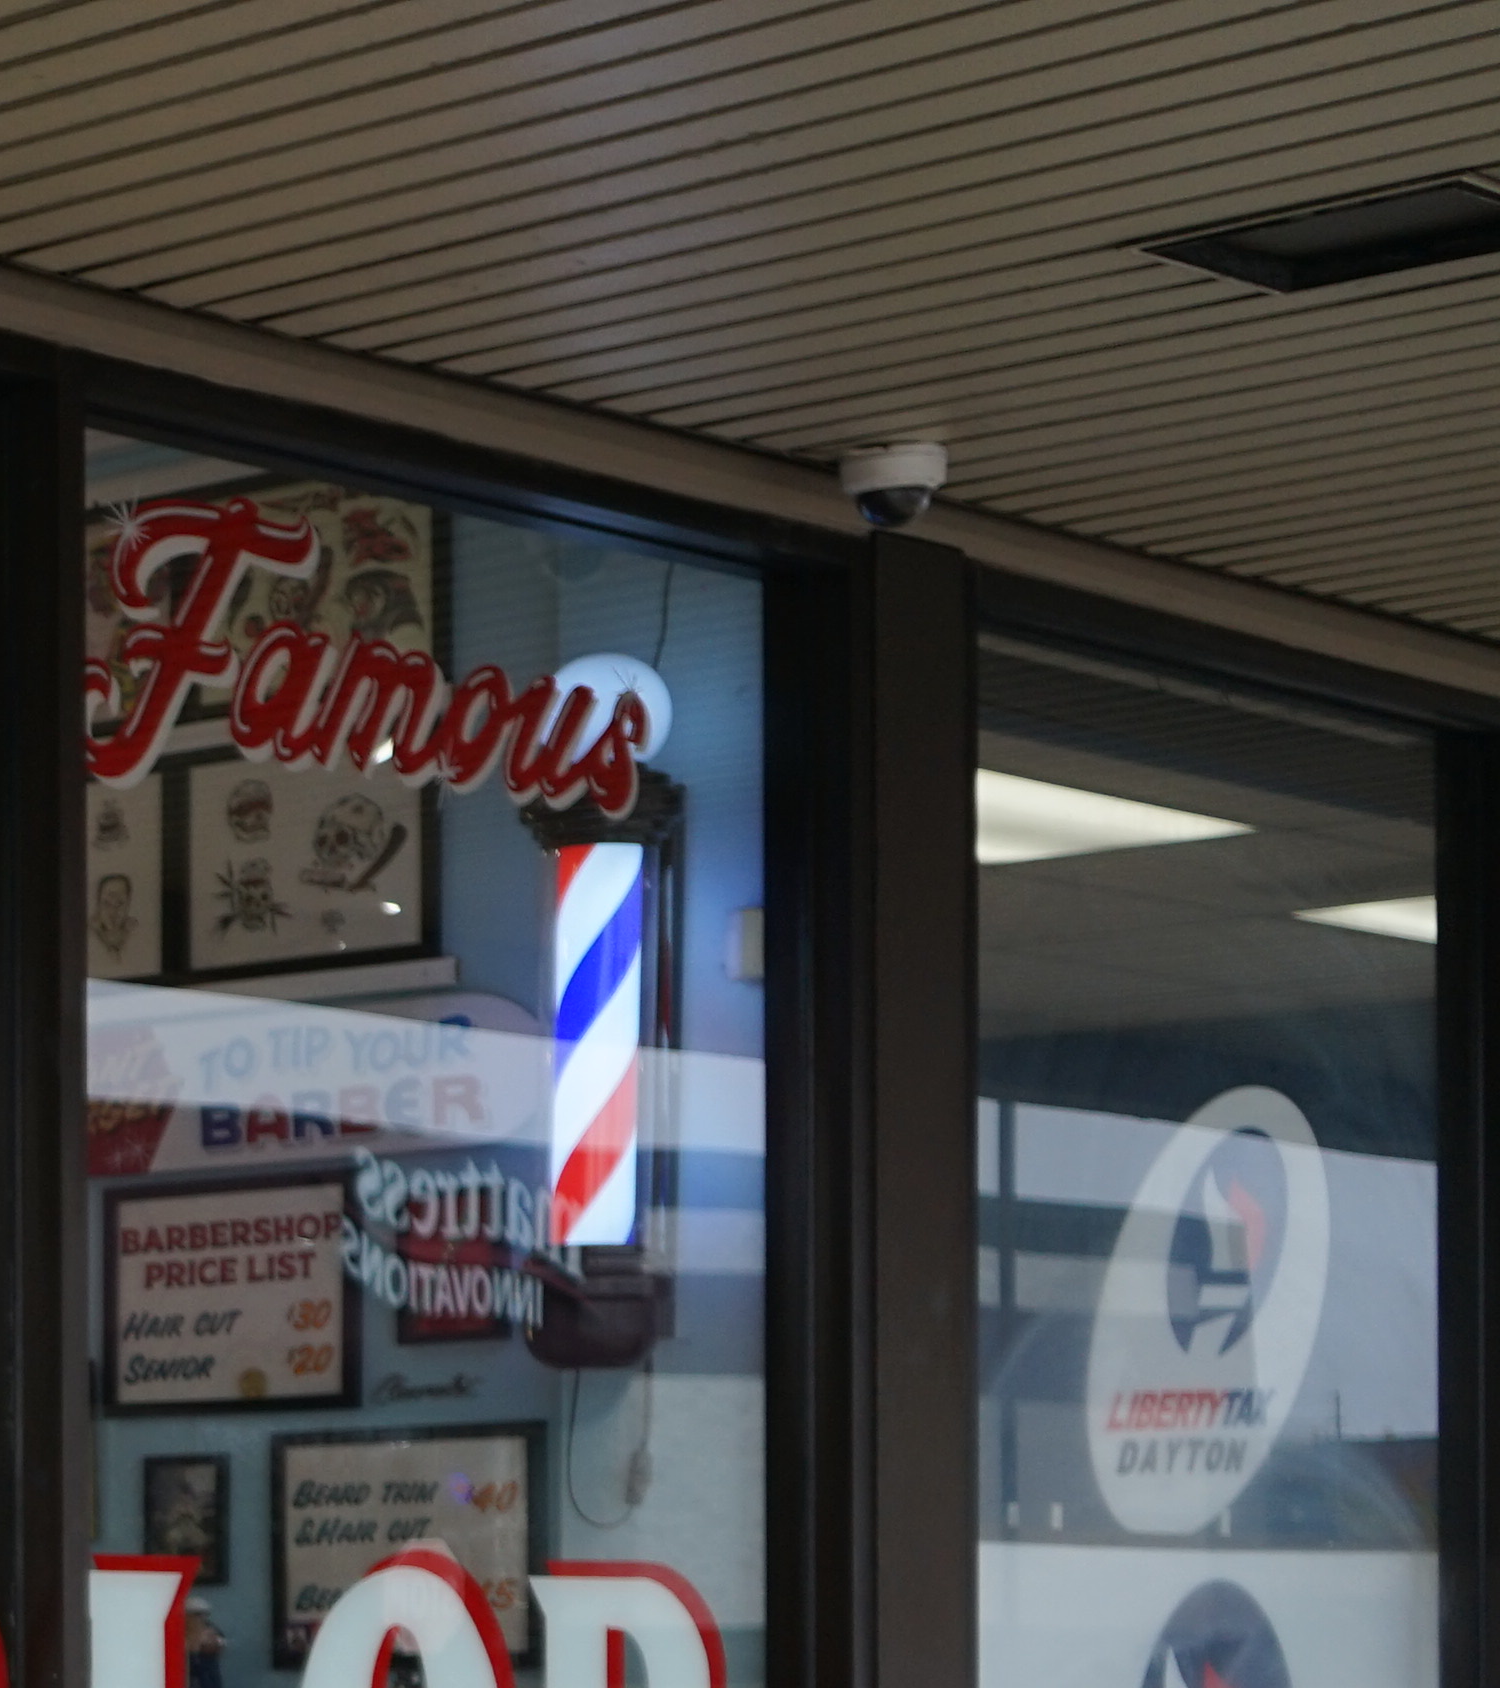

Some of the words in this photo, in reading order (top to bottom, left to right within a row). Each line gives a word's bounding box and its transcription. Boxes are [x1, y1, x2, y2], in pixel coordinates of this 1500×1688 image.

[86, 495, 650, 820] Famous
[200, 1037, 255, 1087] TO
[266, 1025, 331, 1068] TIP
[343, 1015, 472, 1071] YOUR
[201, 1075, 484, 1148] BARBER
[121, 1211, 342, 1255] BARBERSHOP
[144, 1257, 238, 1290] PRICE
[245, 1251, 316, 1282] LIST
[123, 1310, 184, 1341] HAIR
[193, 1308, 243, 1337] CUT
[124, 1351, 215, 1386] SENIOR
[1117, 1438, 1248, 1476] DAYTON
[293, 1478, 372, 1509] BEARD
[382, 1480, 439, 1505] TRIM
[387, 1517, 432, 1543] CUT
